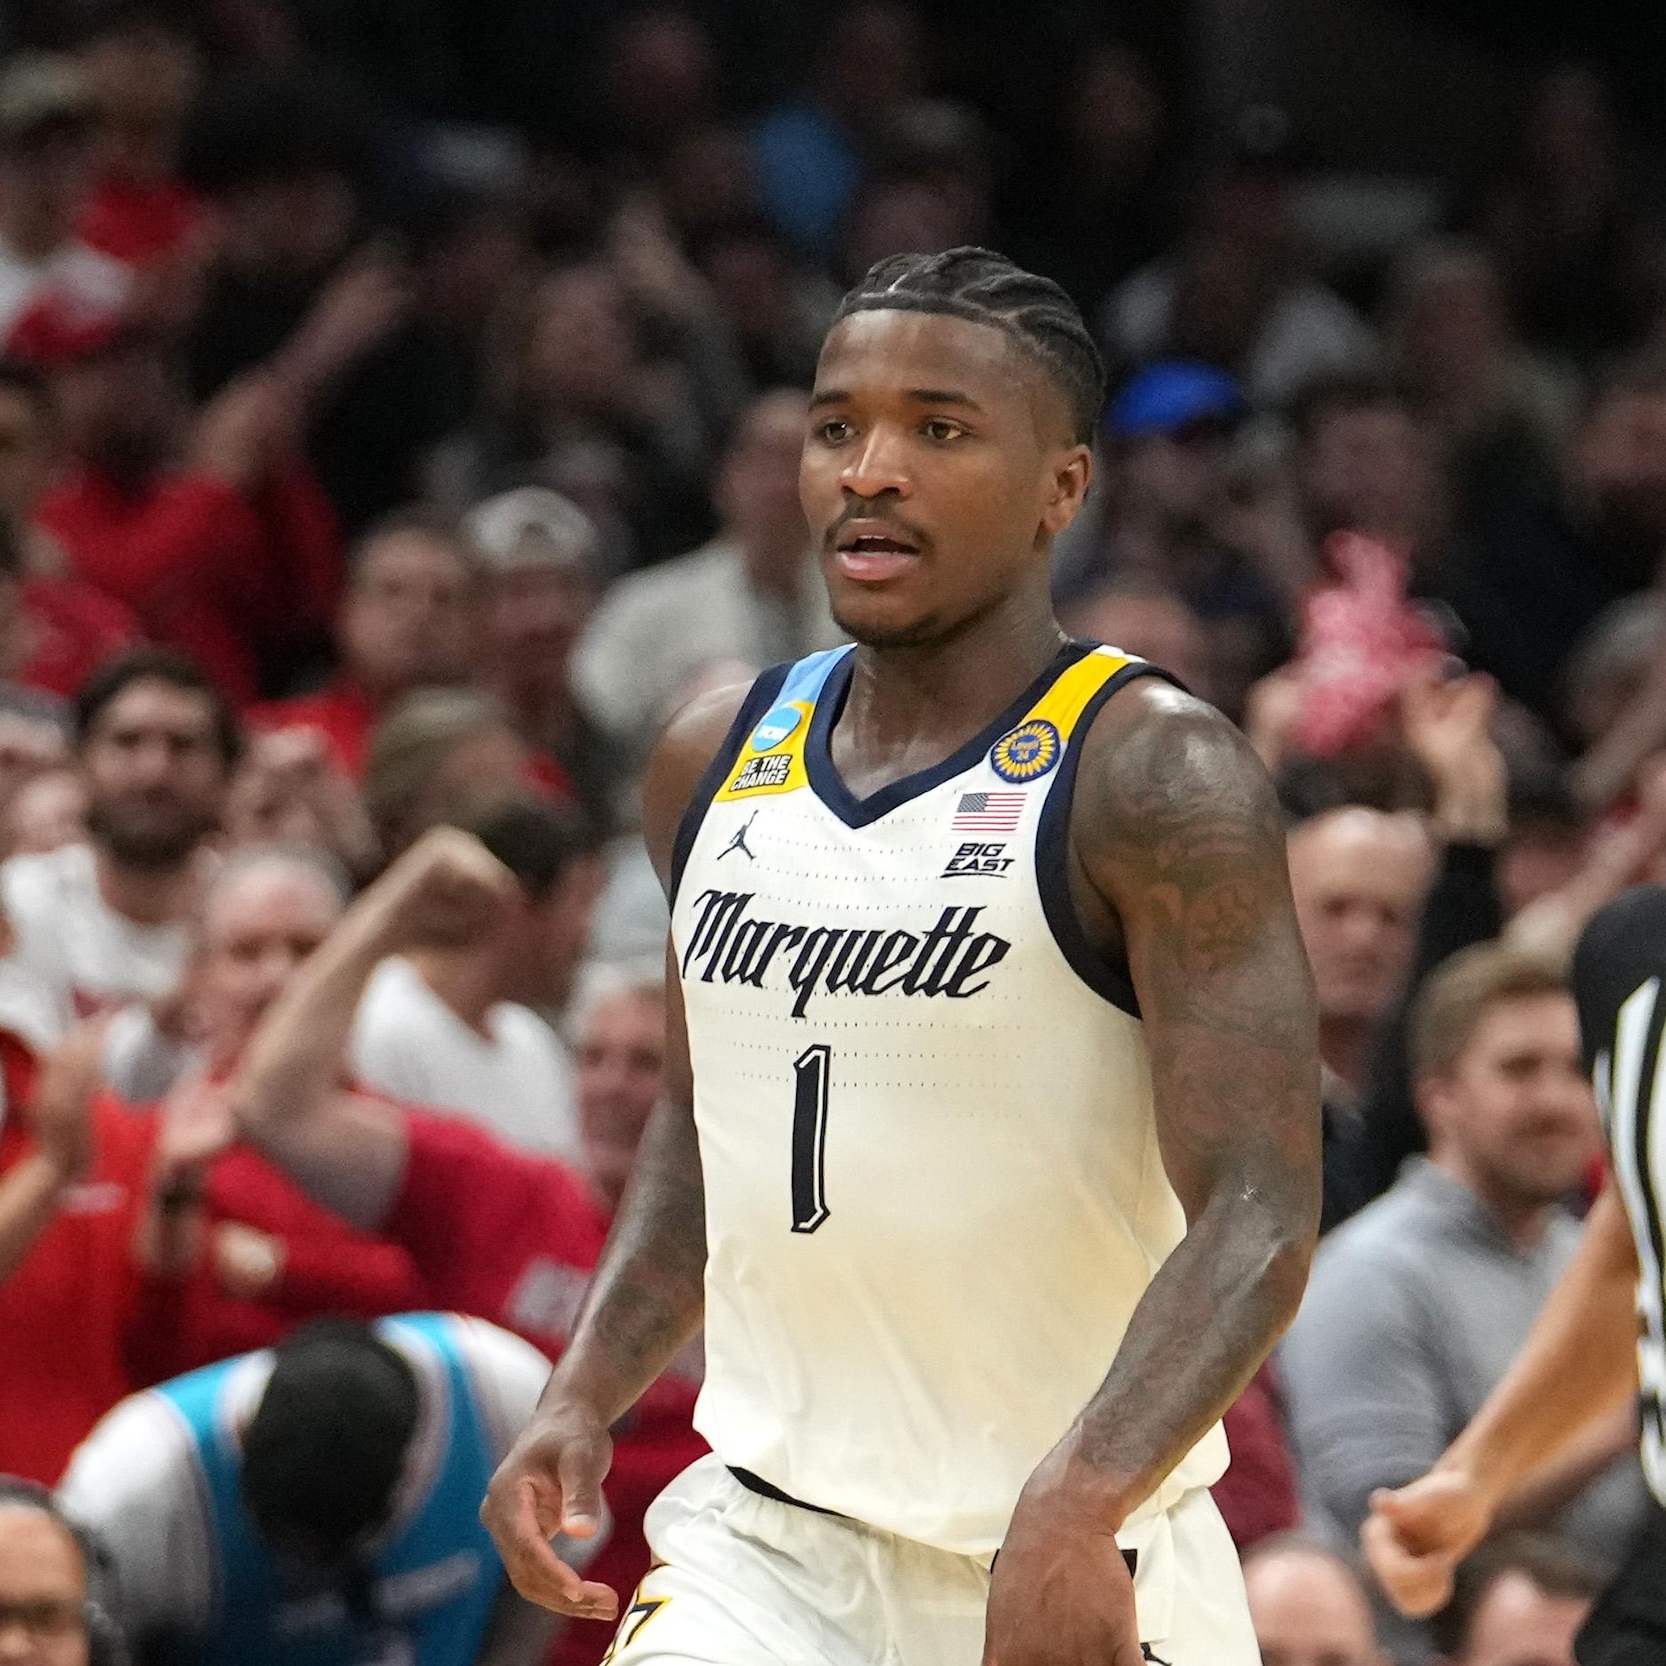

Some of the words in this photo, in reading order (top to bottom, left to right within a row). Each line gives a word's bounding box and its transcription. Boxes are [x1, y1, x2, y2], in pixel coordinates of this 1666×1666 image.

[740, 757, 759, 775] BE
[760, 755, 792, 771] THE
[729, 769, 790, 792] CHANGE
[955, 843, 1007, 857] BIG
[945, 858, 1015, 871] EAST
[683, 889, 1011, 1018] Marquette
[791, 1044, 831, 1233] 1
